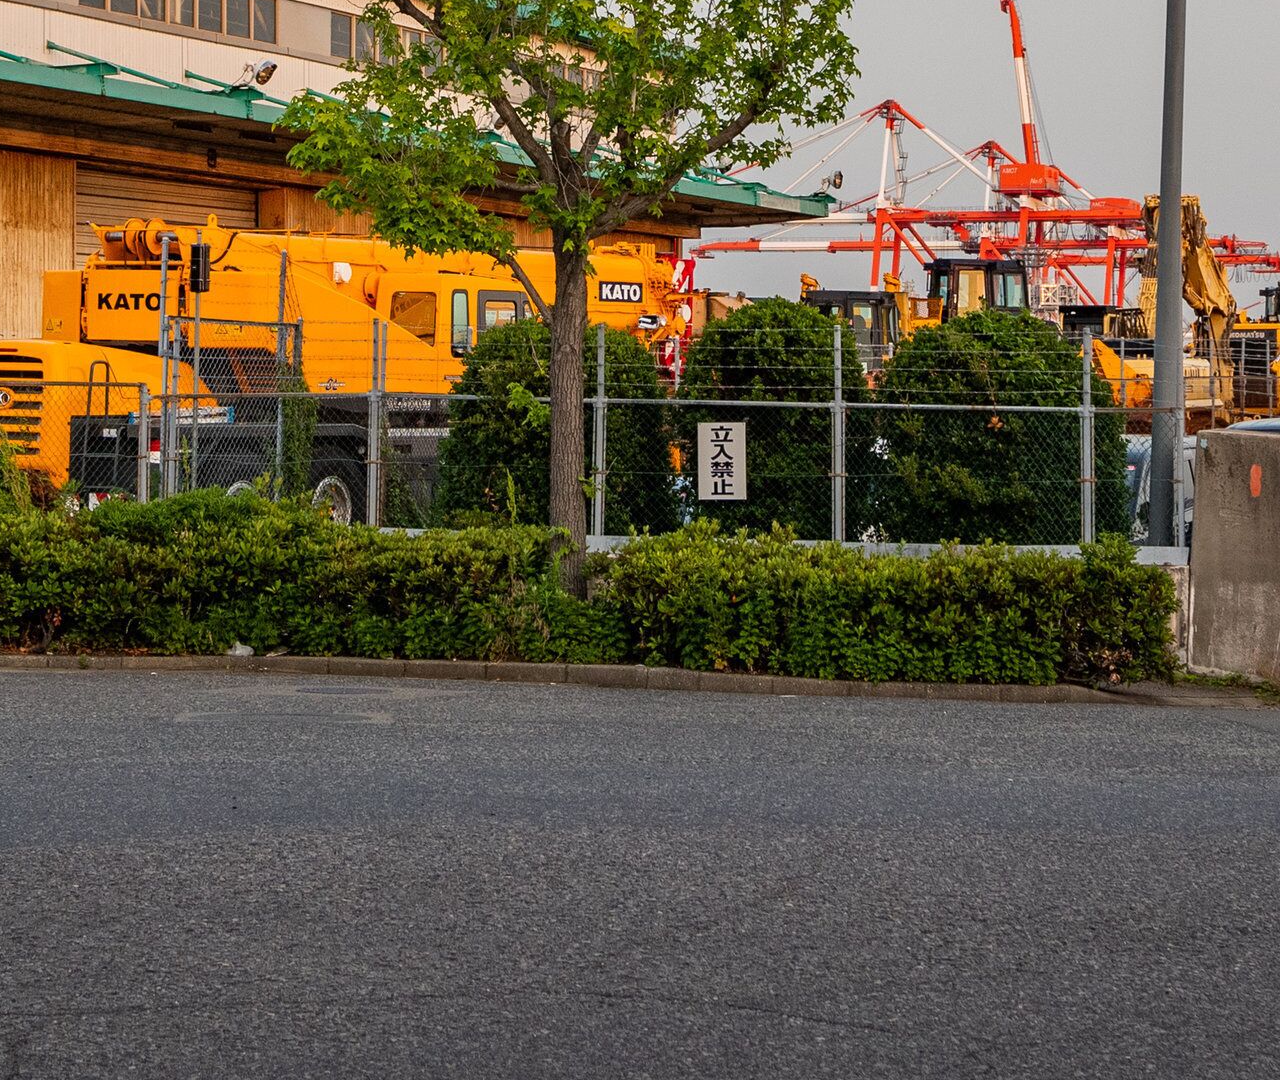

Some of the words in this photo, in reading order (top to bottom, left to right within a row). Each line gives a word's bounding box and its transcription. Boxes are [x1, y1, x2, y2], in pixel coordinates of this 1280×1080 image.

[602, 283, 640, 301] KATO
[98, 293, 161, 311] KATO
[1230, 330, 1265, 339] KOMATSU
[710, 425, 734, 495] 立入禁止
